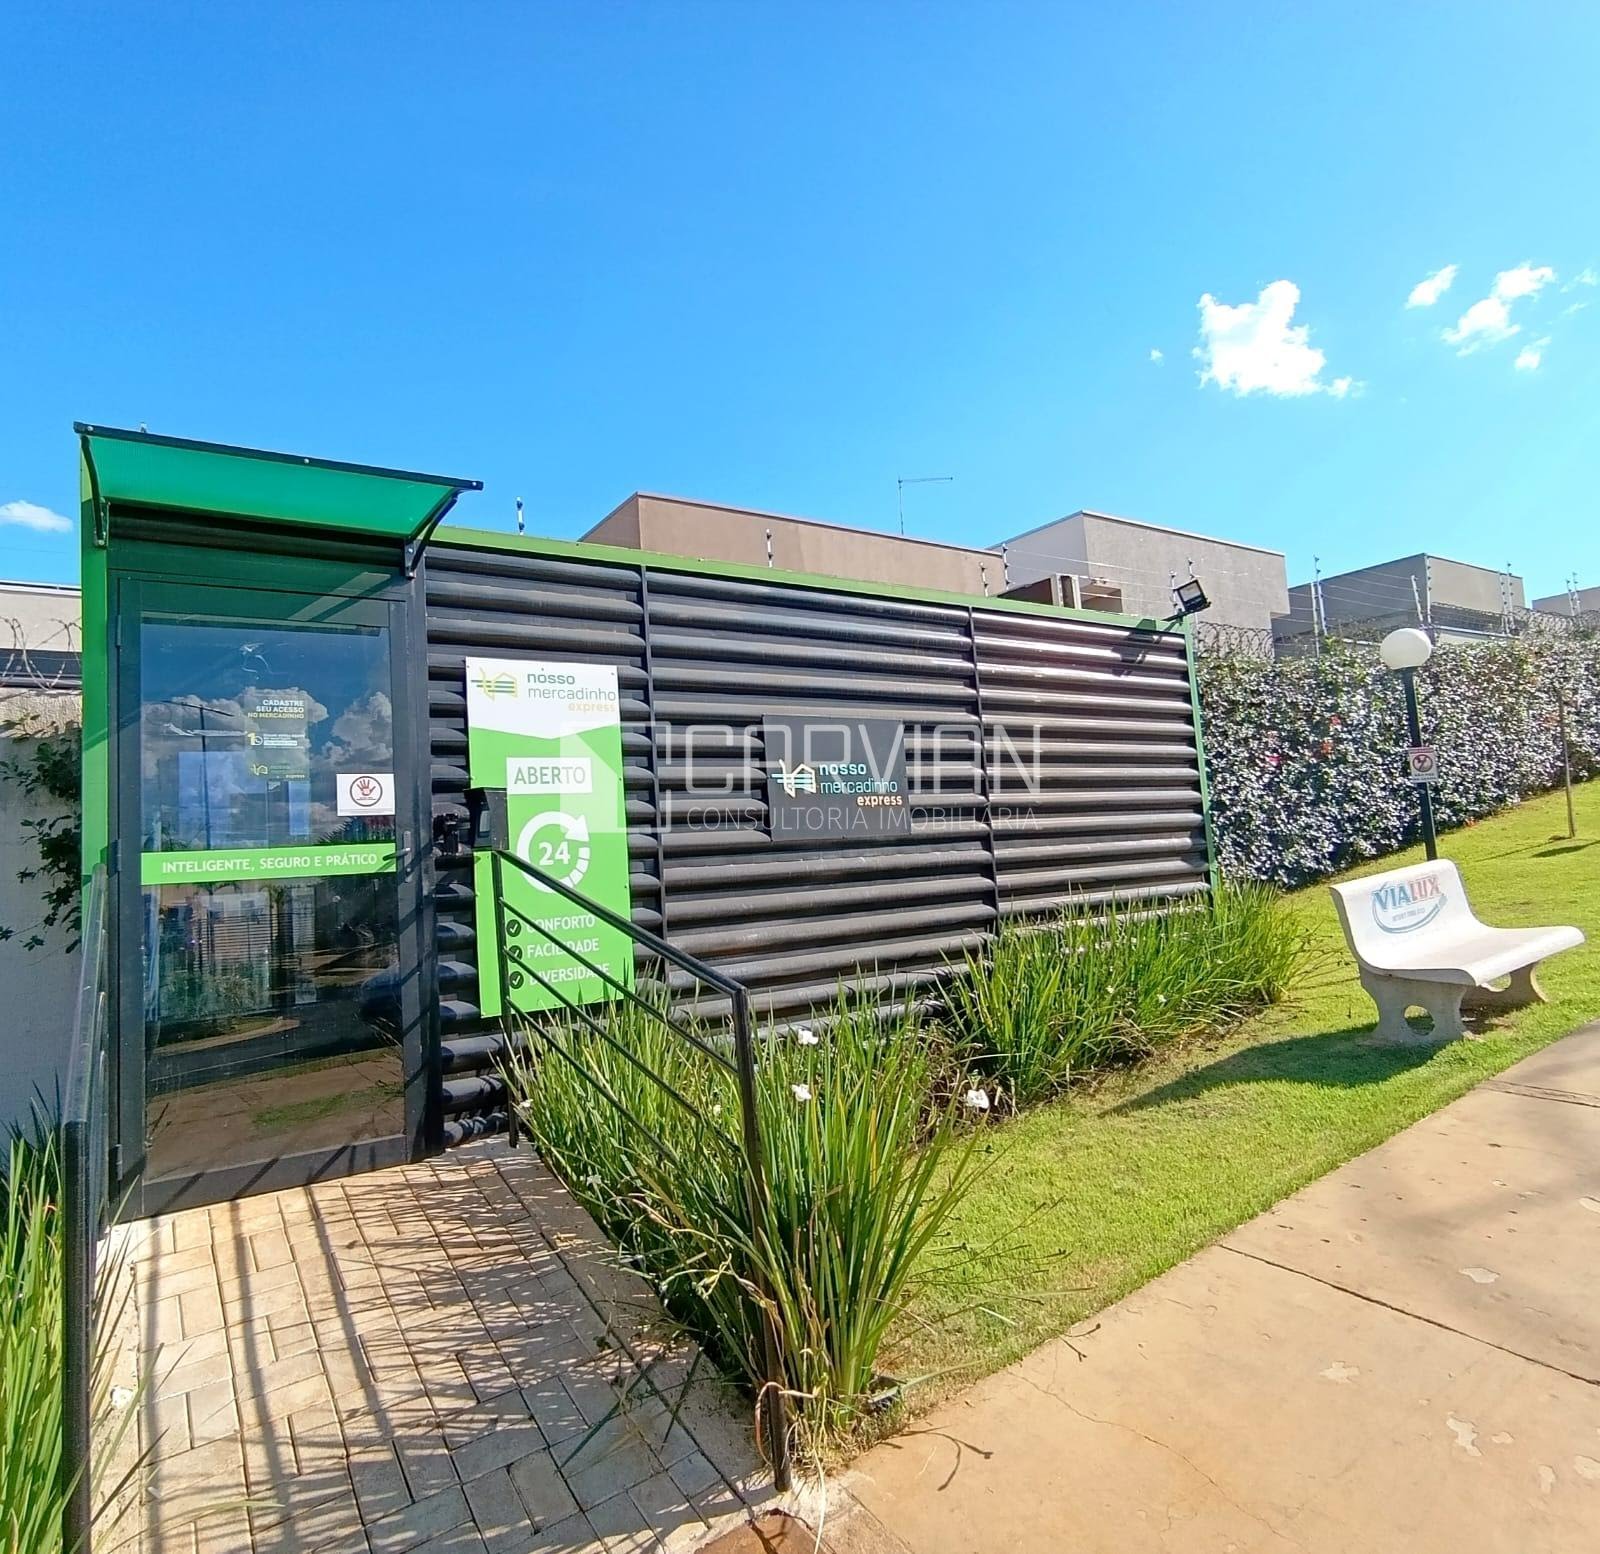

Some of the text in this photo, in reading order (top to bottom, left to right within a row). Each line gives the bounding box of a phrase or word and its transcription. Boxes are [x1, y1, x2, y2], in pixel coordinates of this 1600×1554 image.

[527, 673, 575, 685] nosso
[528, 687, 616, 701] mercadinho
[568, 702, 616, 713] express
[514, 766, 586, 785] ABERTO
[819, 762, 867, 775] nosso
[820, 779, 898, 794] mercadinho
[857, 794, 902, 808] express
[539, 841, 571, 866] 24
[162, 853, 377, 874] INTELIGENTE, SEGURO E PRÁTICO
[1373, 877, 1440, 911] VIALUX
